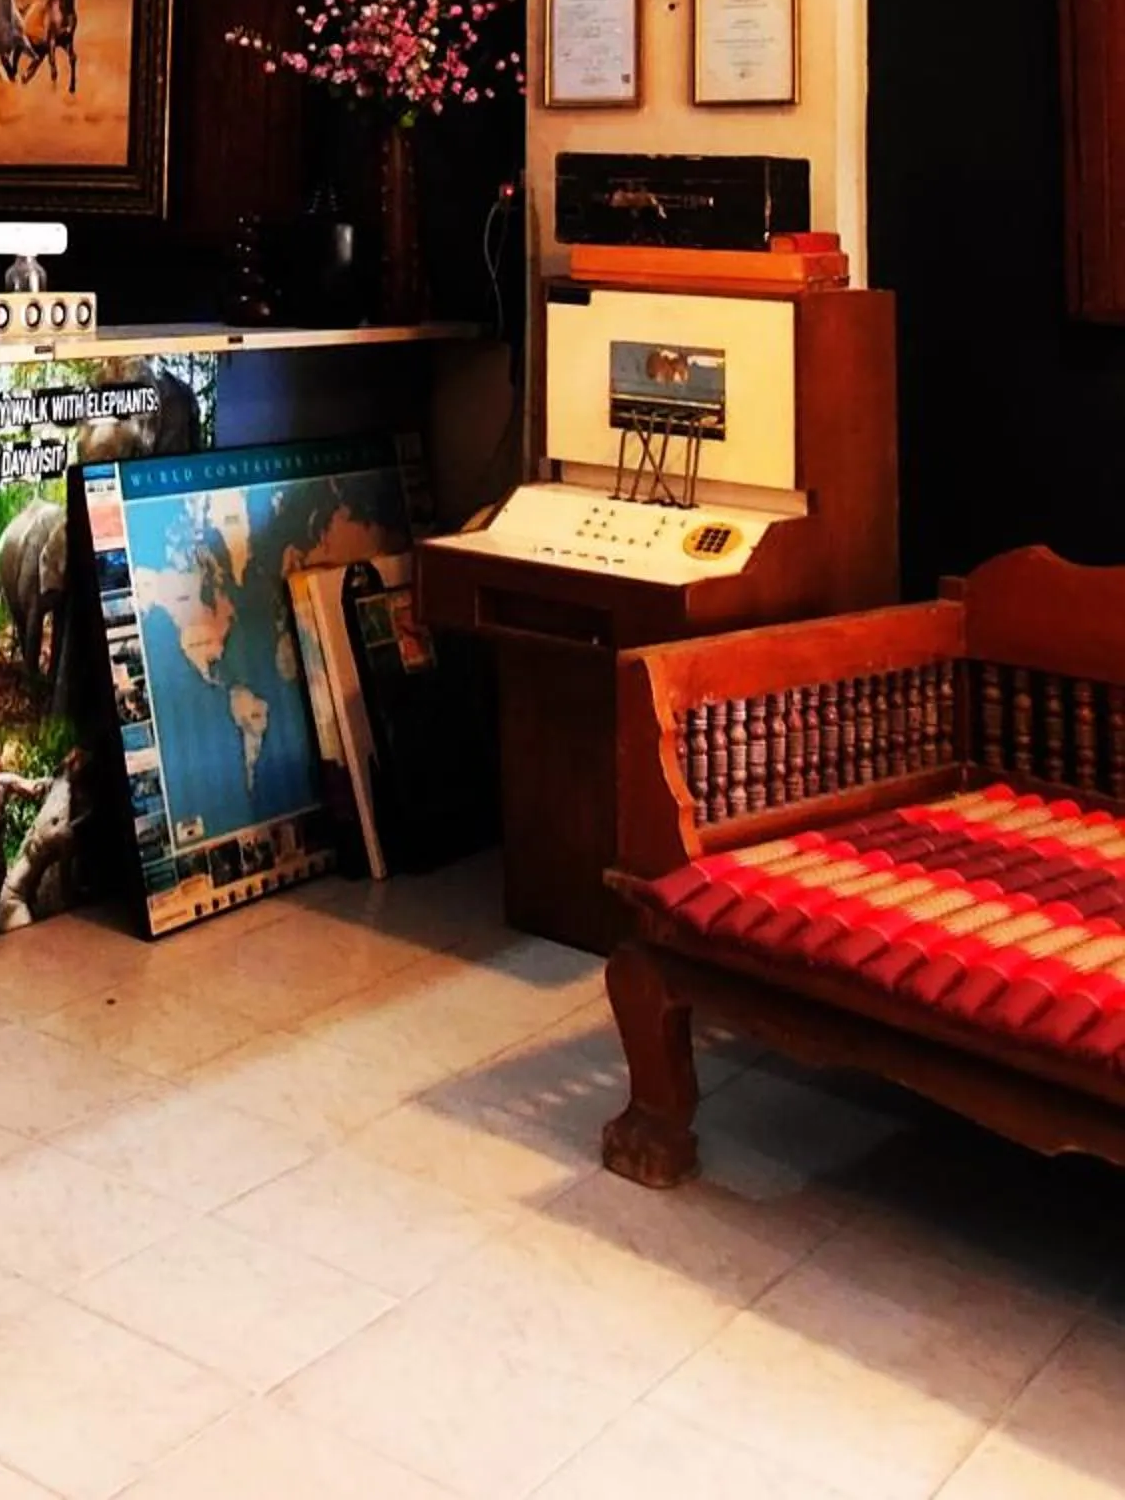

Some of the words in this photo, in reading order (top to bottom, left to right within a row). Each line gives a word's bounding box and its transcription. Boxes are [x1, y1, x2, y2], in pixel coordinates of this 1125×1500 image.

[12, 397, 49, 426] WALK
[52, 393, 84, 421] WITH
[2, 449, 28, 476] DAY
[29, 444, 65, 474] VISIT
